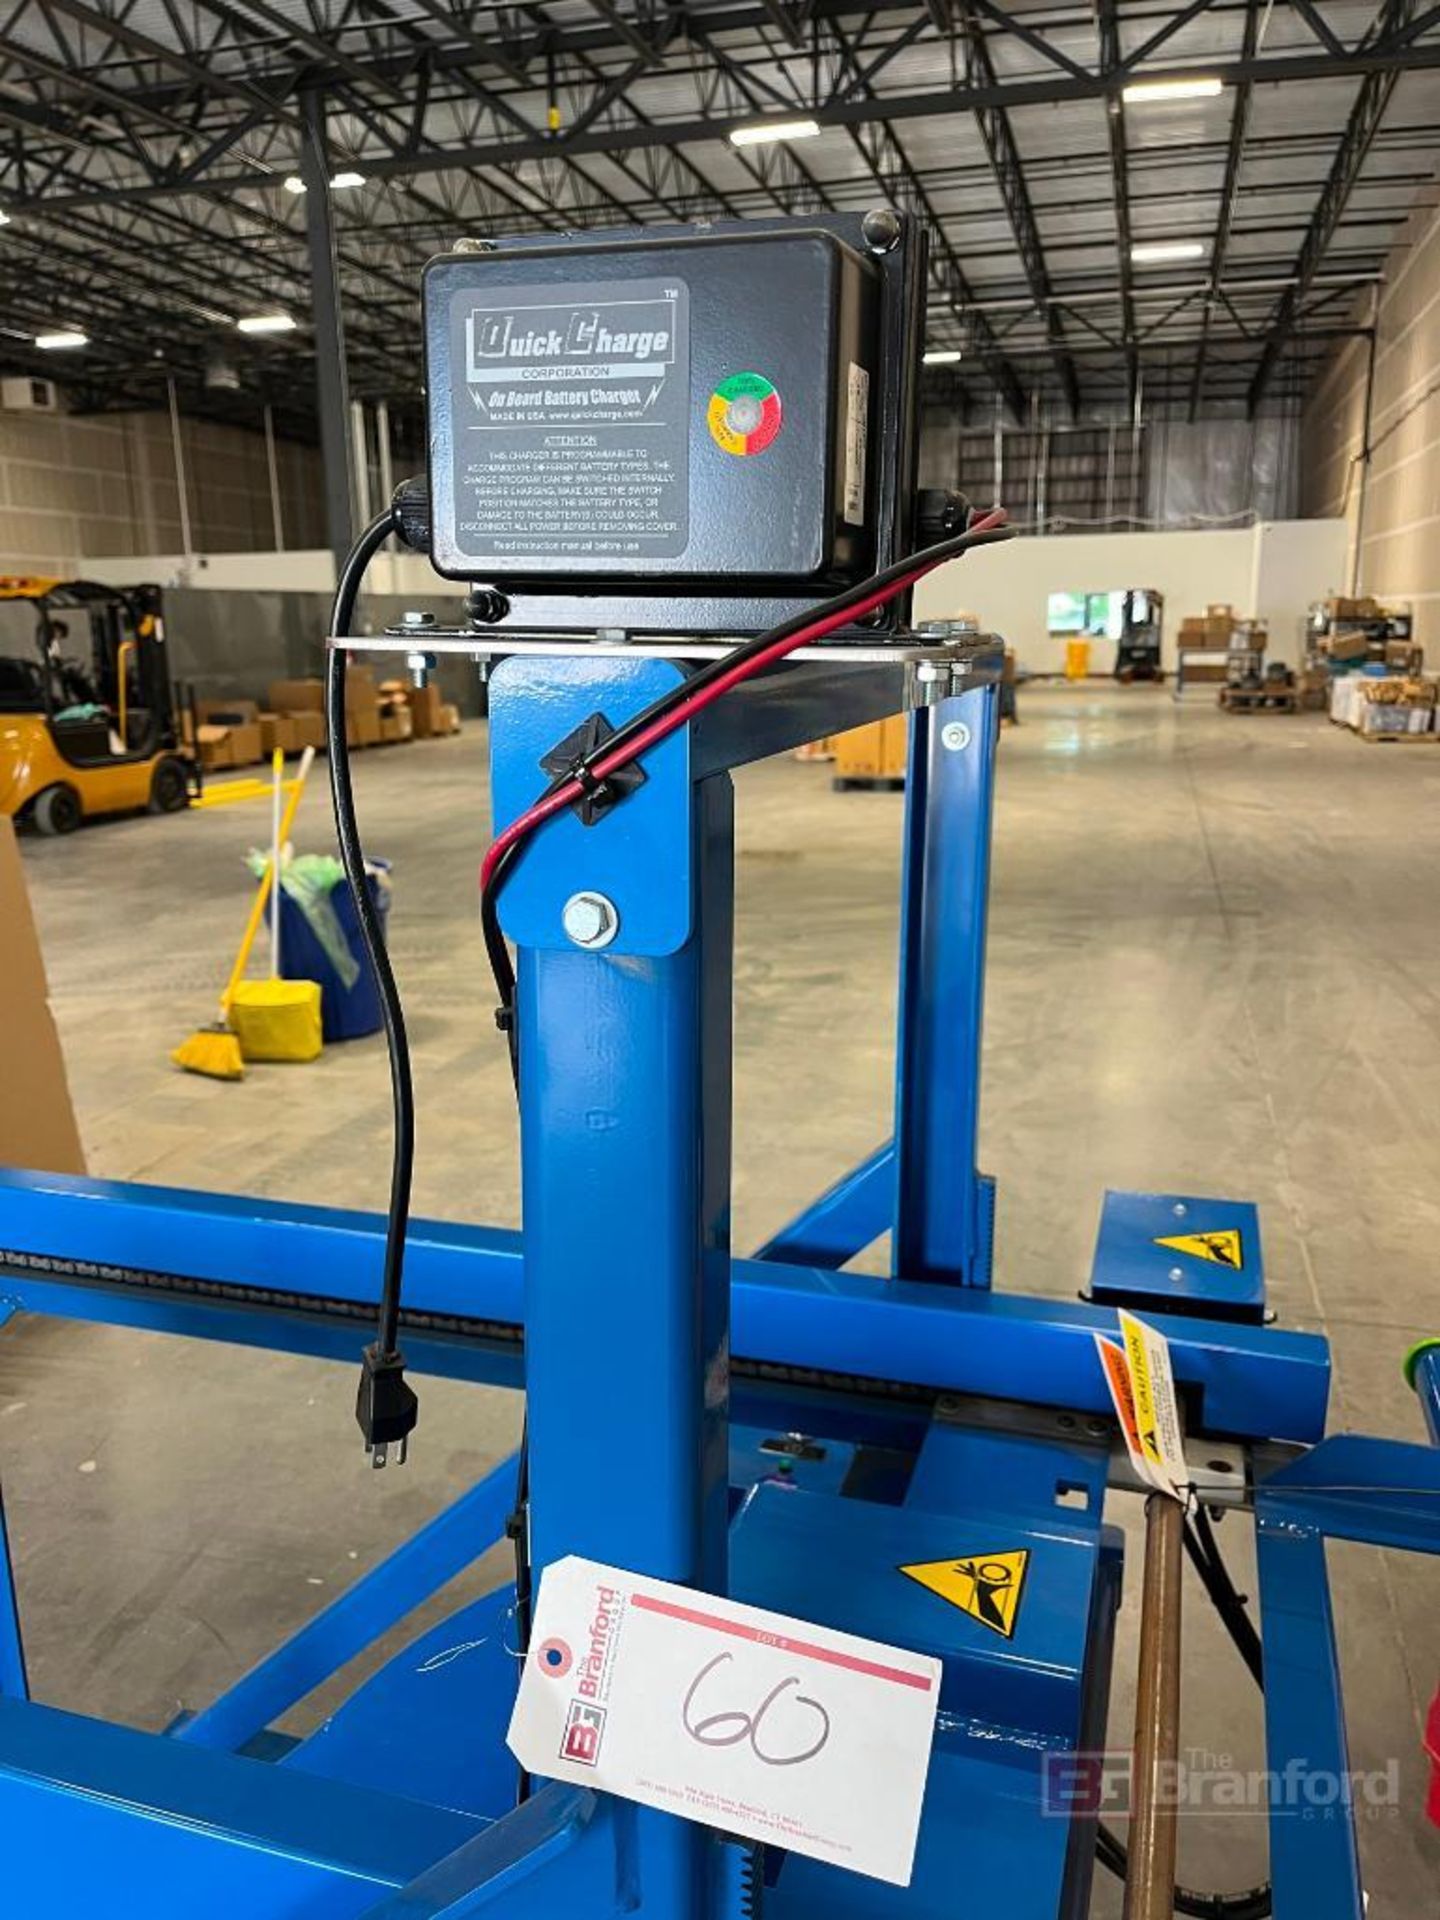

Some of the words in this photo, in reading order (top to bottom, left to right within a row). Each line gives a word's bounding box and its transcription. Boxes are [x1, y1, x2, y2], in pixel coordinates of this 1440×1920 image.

[522, 367, 610, 379] CORPORATION
[507, 391, 542, 406] Board
[545, 390, 588, 406] Battery
[490, 413, 513, 421] MADE
[544, 436, 597, 446] ATTENTION
[1130, 1336, 1149, 1414] CAUTION
[578, 1585, 615, 1699] Branford
[683, 1651, 830, 1766] 60
